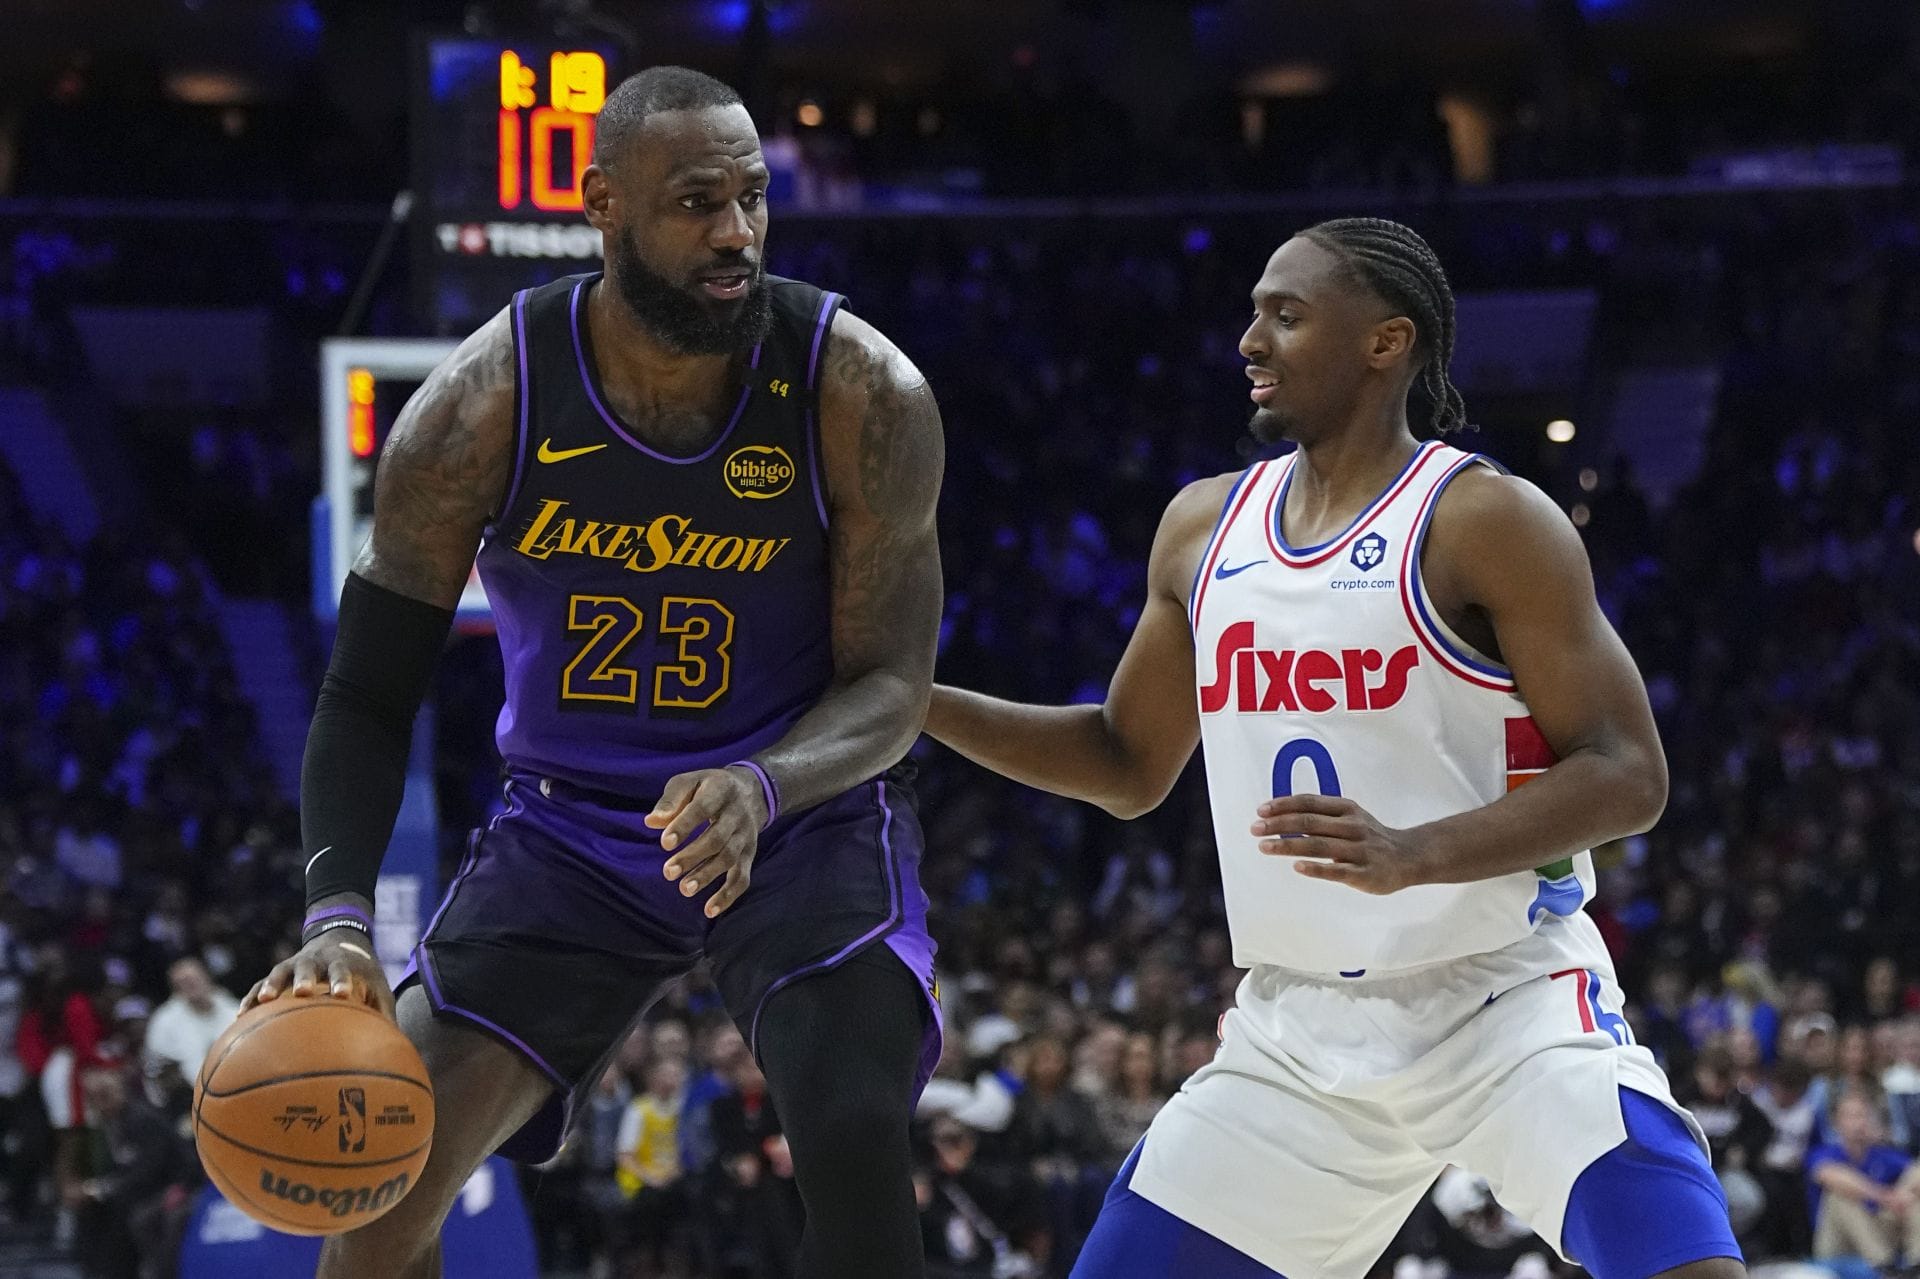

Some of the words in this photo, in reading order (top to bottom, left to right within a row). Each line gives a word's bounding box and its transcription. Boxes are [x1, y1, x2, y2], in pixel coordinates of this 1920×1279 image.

[498, 106, 597, 212] 10
[769, 378, 789, 397] 44
[730, 460, 790, 483] bibigo
[740, 478, 765, 487] 비비고
[1330, 577, 1395, 590] crypto.com
[561, 594, 735, 709] 23
[1199, 621, 1420, 713] Sixers
[261, 1168, 409, 1217] Wilson
